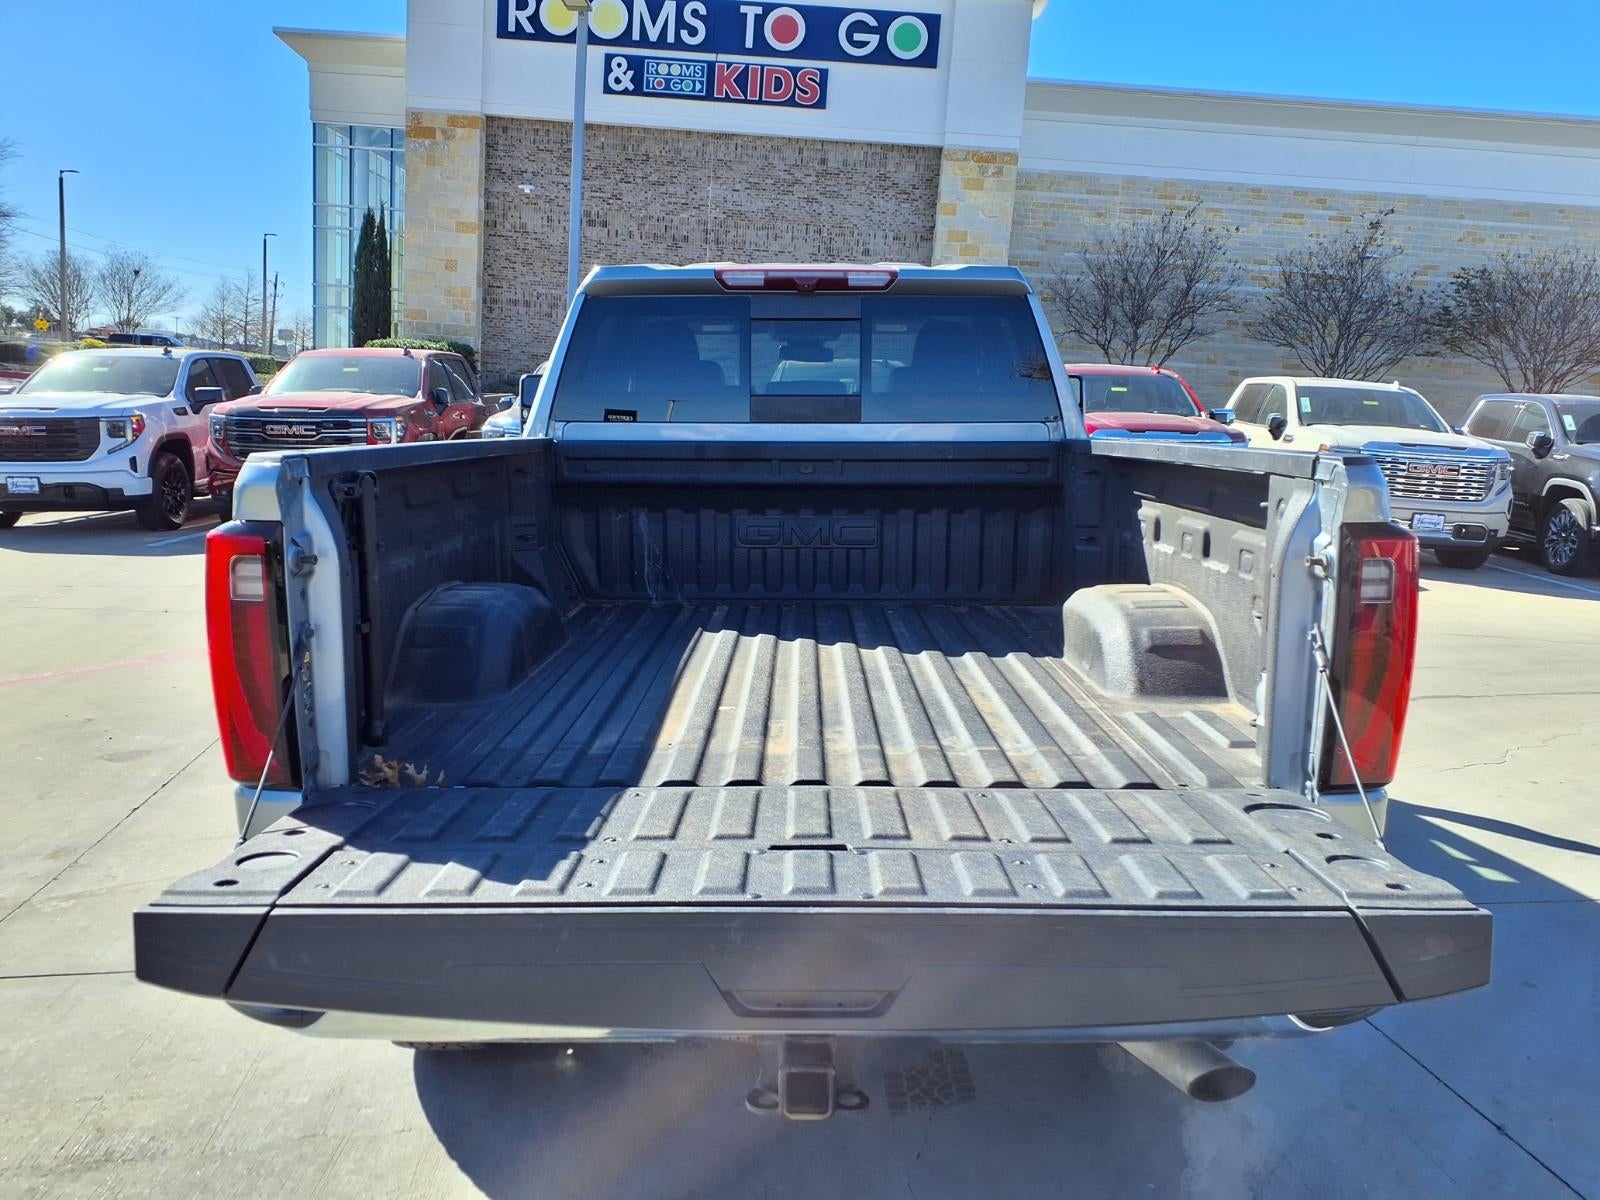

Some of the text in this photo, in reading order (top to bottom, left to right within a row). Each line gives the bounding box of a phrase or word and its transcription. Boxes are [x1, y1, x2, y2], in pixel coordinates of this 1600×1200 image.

[507, 0, 929, 60] ROOMS TO GO
[608, 56, 635, 92] &
[648, 62, 703, 77] ROOMS
[648, 77, 693, 92] TO GO
[714, 63, 821, 105] KIDS
[265, 424, 317, 435] GMC
[1408, 463, 1460, 476] GMC
[737, 518, 876, 546] GMC
